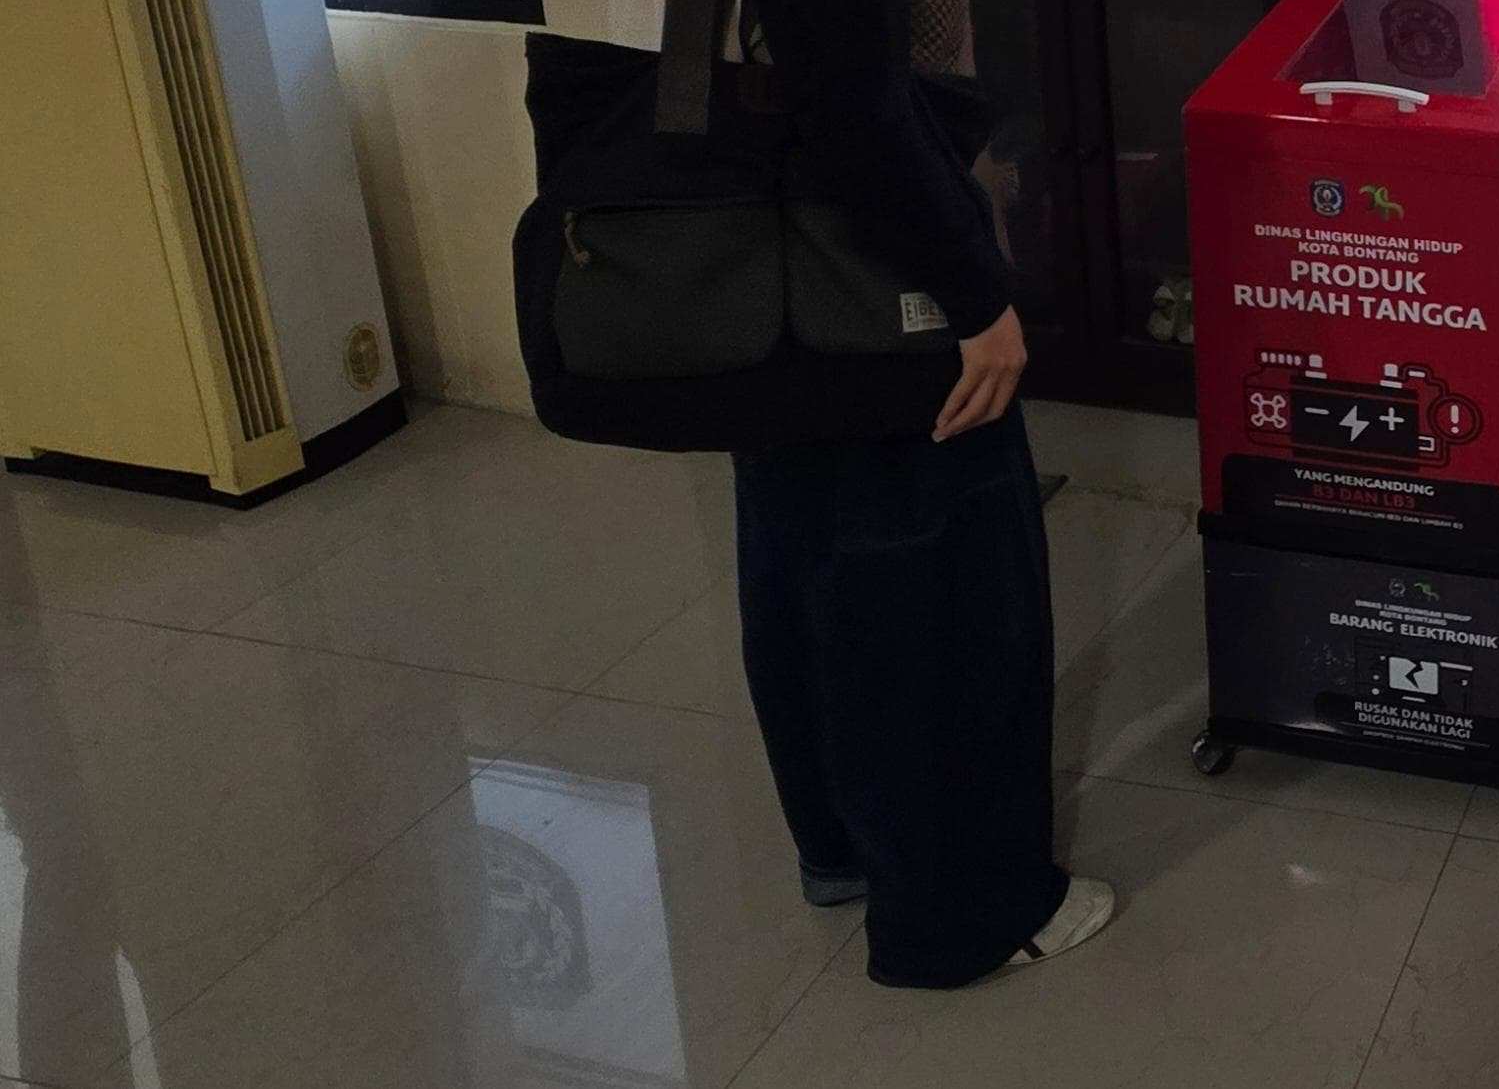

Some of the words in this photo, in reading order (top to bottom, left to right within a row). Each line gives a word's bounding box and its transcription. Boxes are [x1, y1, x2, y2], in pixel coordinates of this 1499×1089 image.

[1254, 223, 1302, 239] DINAS
[1305, 227, 1410, 250] LINGKUNGAN
[1413, 237, 1464, 255] HIDUP
[1297, 240, 1341, 257] KOTA
[1343, 244, 1420, 264] BONTANG
[1290, 259, 1427, 296] PRODUK
[1232, 283, 1351, 317] RUMAH
[1357, 295, 1488, 332] TANGGA
[1293, 468, 1333, 483] YANG
[1333, 473, 1435, 497] MENGANDUNG
[1339, 487, 1378, 503] DAN
[1328, 612, 1395, 633] BARANG
[1400, 623, 1499, 650] ELEKTRONIK
[1353, 701, 1399, 716] RUSAK
[1401, 707, 1431, 721] DAN
[1433, 713, 1474, 729] TIDAK
[1357, 712, 1438, 734] DIGUNAKAN
[1440, 724, 1471, 740] LAGI
